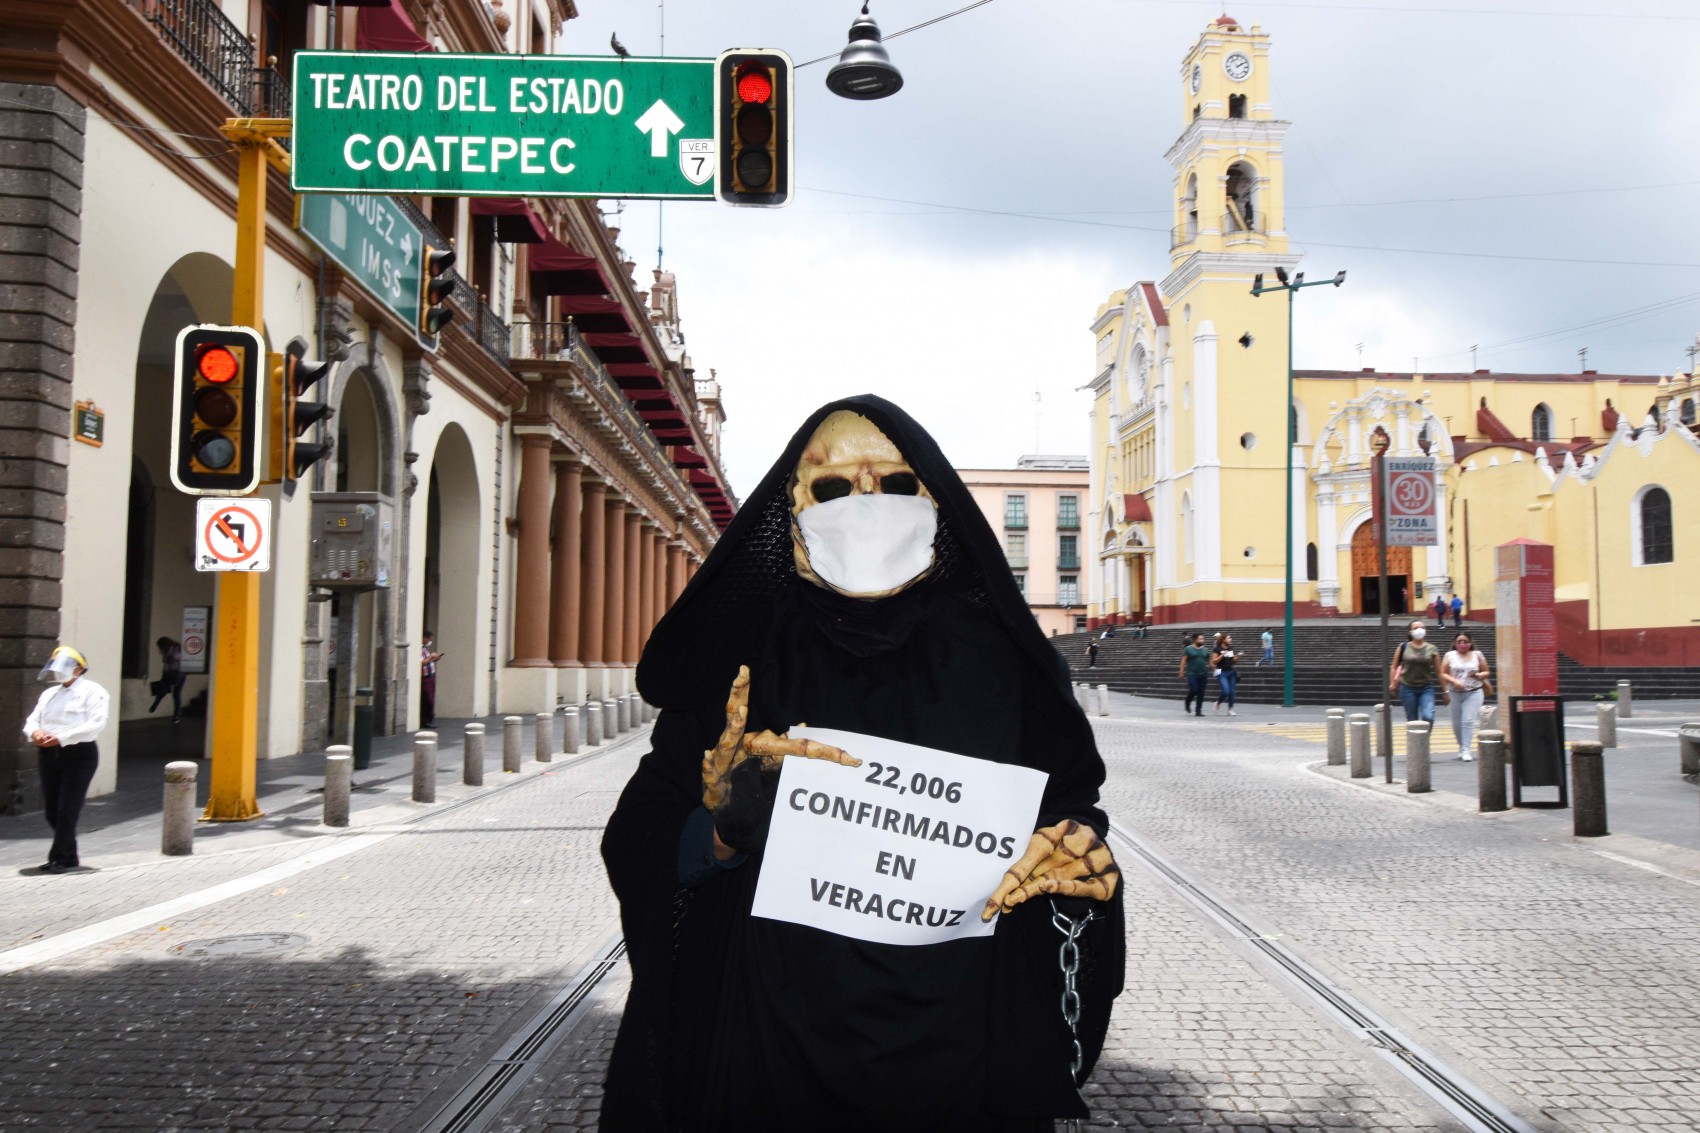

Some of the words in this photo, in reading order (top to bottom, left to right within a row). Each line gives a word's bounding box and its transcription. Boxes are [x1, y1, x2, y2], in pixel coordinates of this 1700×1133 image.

[310, 73, 423, 111] TEATRO
[438, 75, 497, 112] DEL
[510, 77, 624, 115] ESTADO
[343, 133, 576, 174] COATEPEC
[688, 142, 708, 151] VER
[690, 157, 705, 176] 7
[362, 237, 402, 298] IMSS
[1400, 480, 1425, 501] 30
[1397, 518, 1428, 528] ZONA
[865, 762, 963, 804] 22,006
[789, 788, 1016, 859] CONFIRMADOS
[875, 851, 917, 881] EN
[810, 877, 966, 928] VERACRUZ
